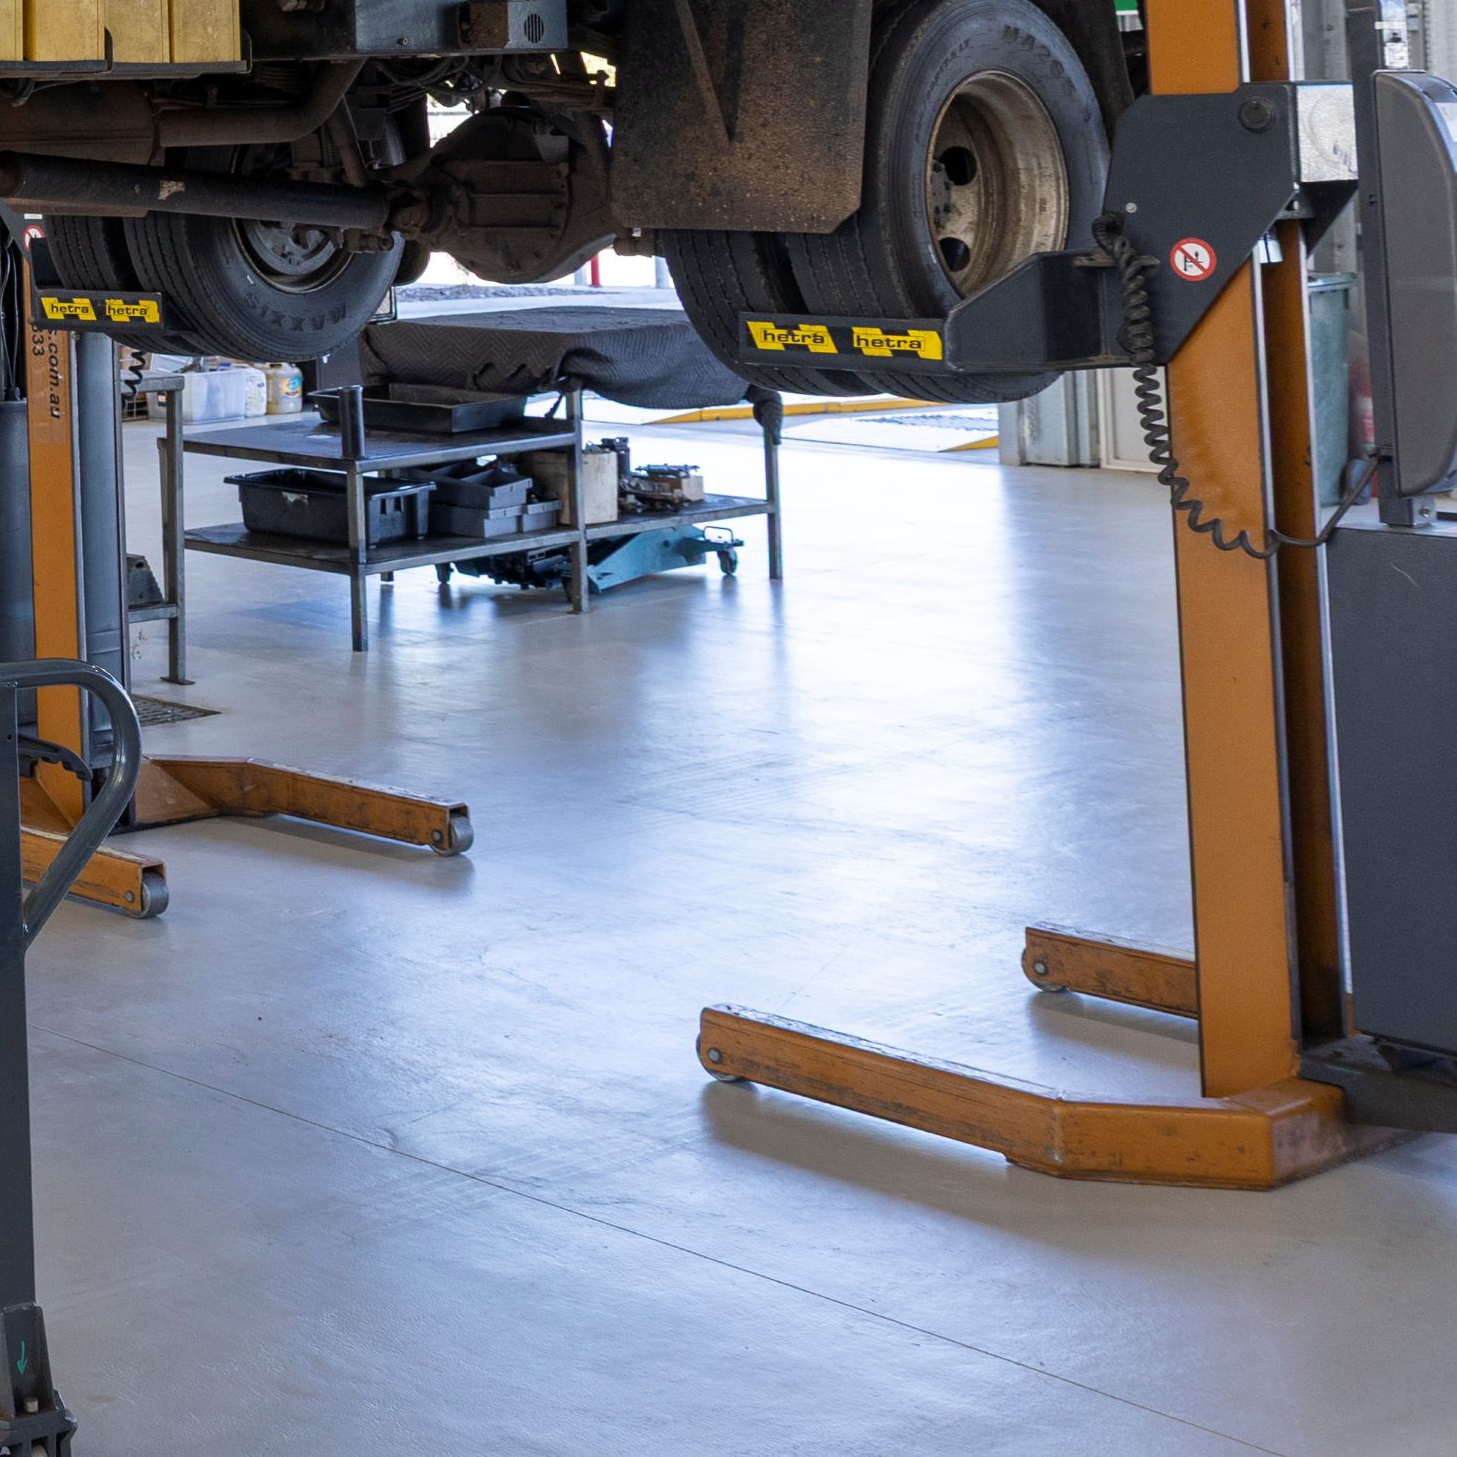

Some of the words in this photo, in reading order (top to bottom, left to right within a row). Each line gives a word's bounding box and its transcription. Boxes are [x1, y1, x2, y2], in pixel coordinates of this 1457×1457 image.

[50, 303, 90, 314] hetra
[107, 305, 148, 316] hetra
[763, 329, 825, 344] hetra
[856, 334, 922, 349] hetra
